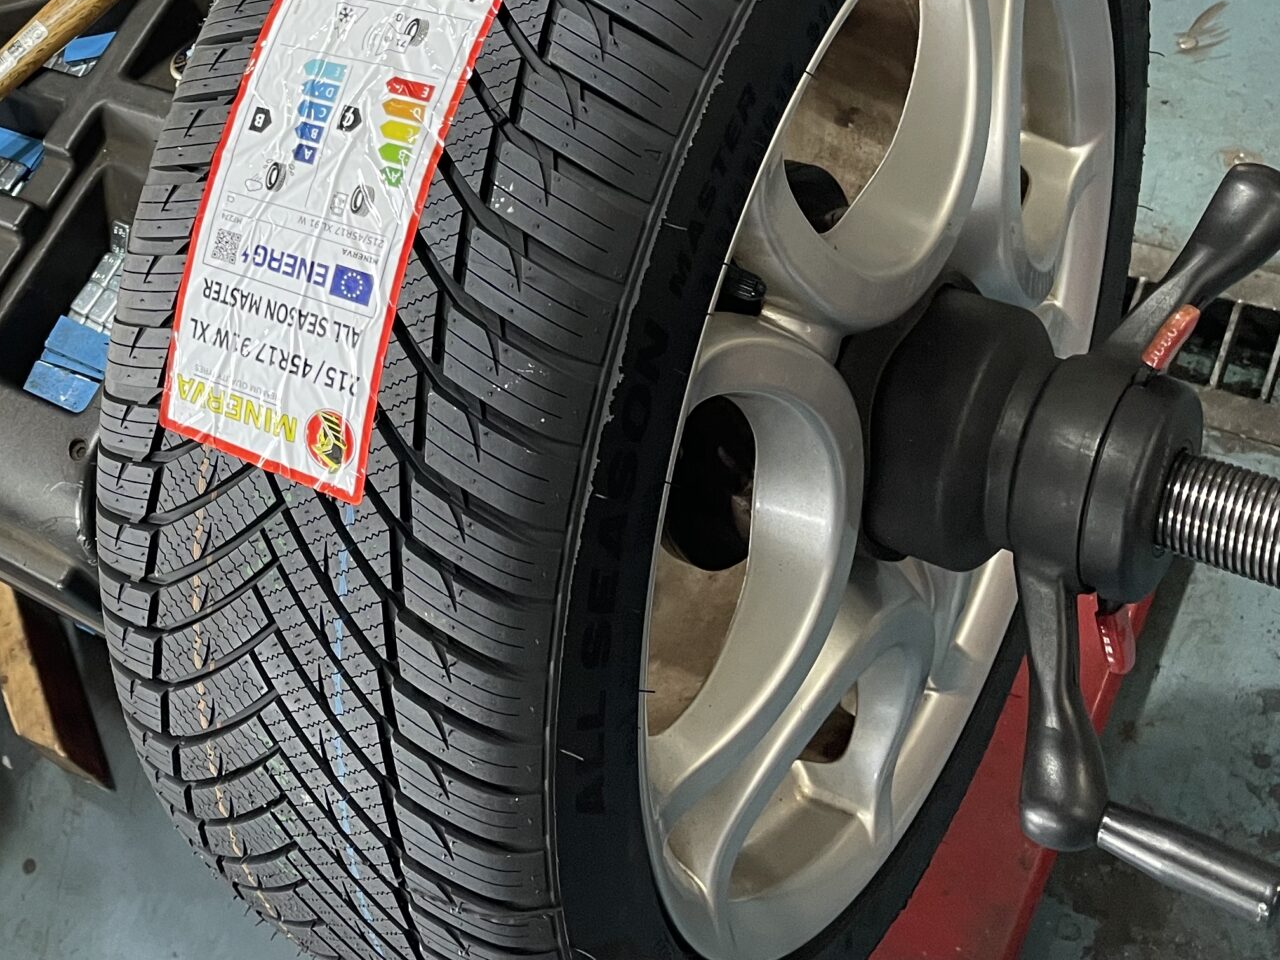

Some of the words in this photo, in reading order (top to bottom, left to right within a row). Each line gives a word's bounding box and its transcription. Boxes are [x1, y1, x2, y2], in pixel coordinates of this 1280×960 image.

[255, 114, 265, 126] B
[253, 244, 330, 288] ENERG
[203, 278, 262, 313] MASTER
[190, 318, 210, 343] XL
[265, 298, 328, 337] SEASON
[333, 321, 363, 348] ALL
[177, 372, 298, 443] MINERVA
